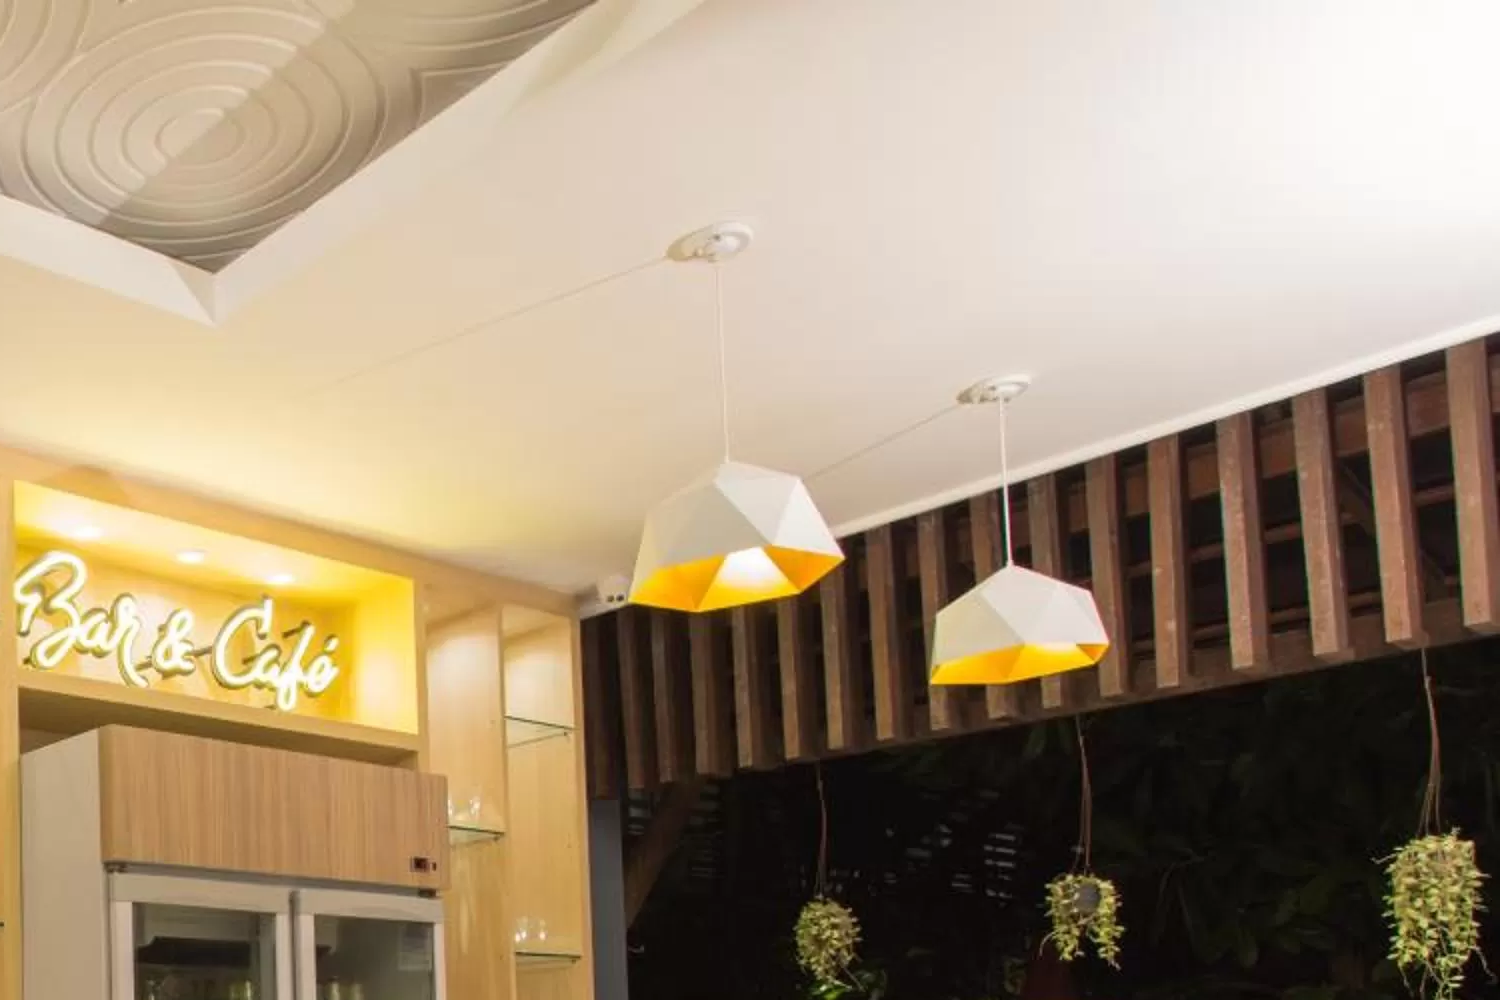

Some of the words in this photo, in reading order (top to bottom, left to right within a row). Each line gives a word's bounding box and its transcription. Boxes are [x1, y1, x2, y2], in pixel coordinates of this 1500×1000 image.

[13, 549, 150, 688] Bar
[153, 608, 196, 677] &
[211, 595, 341, 711] Café
